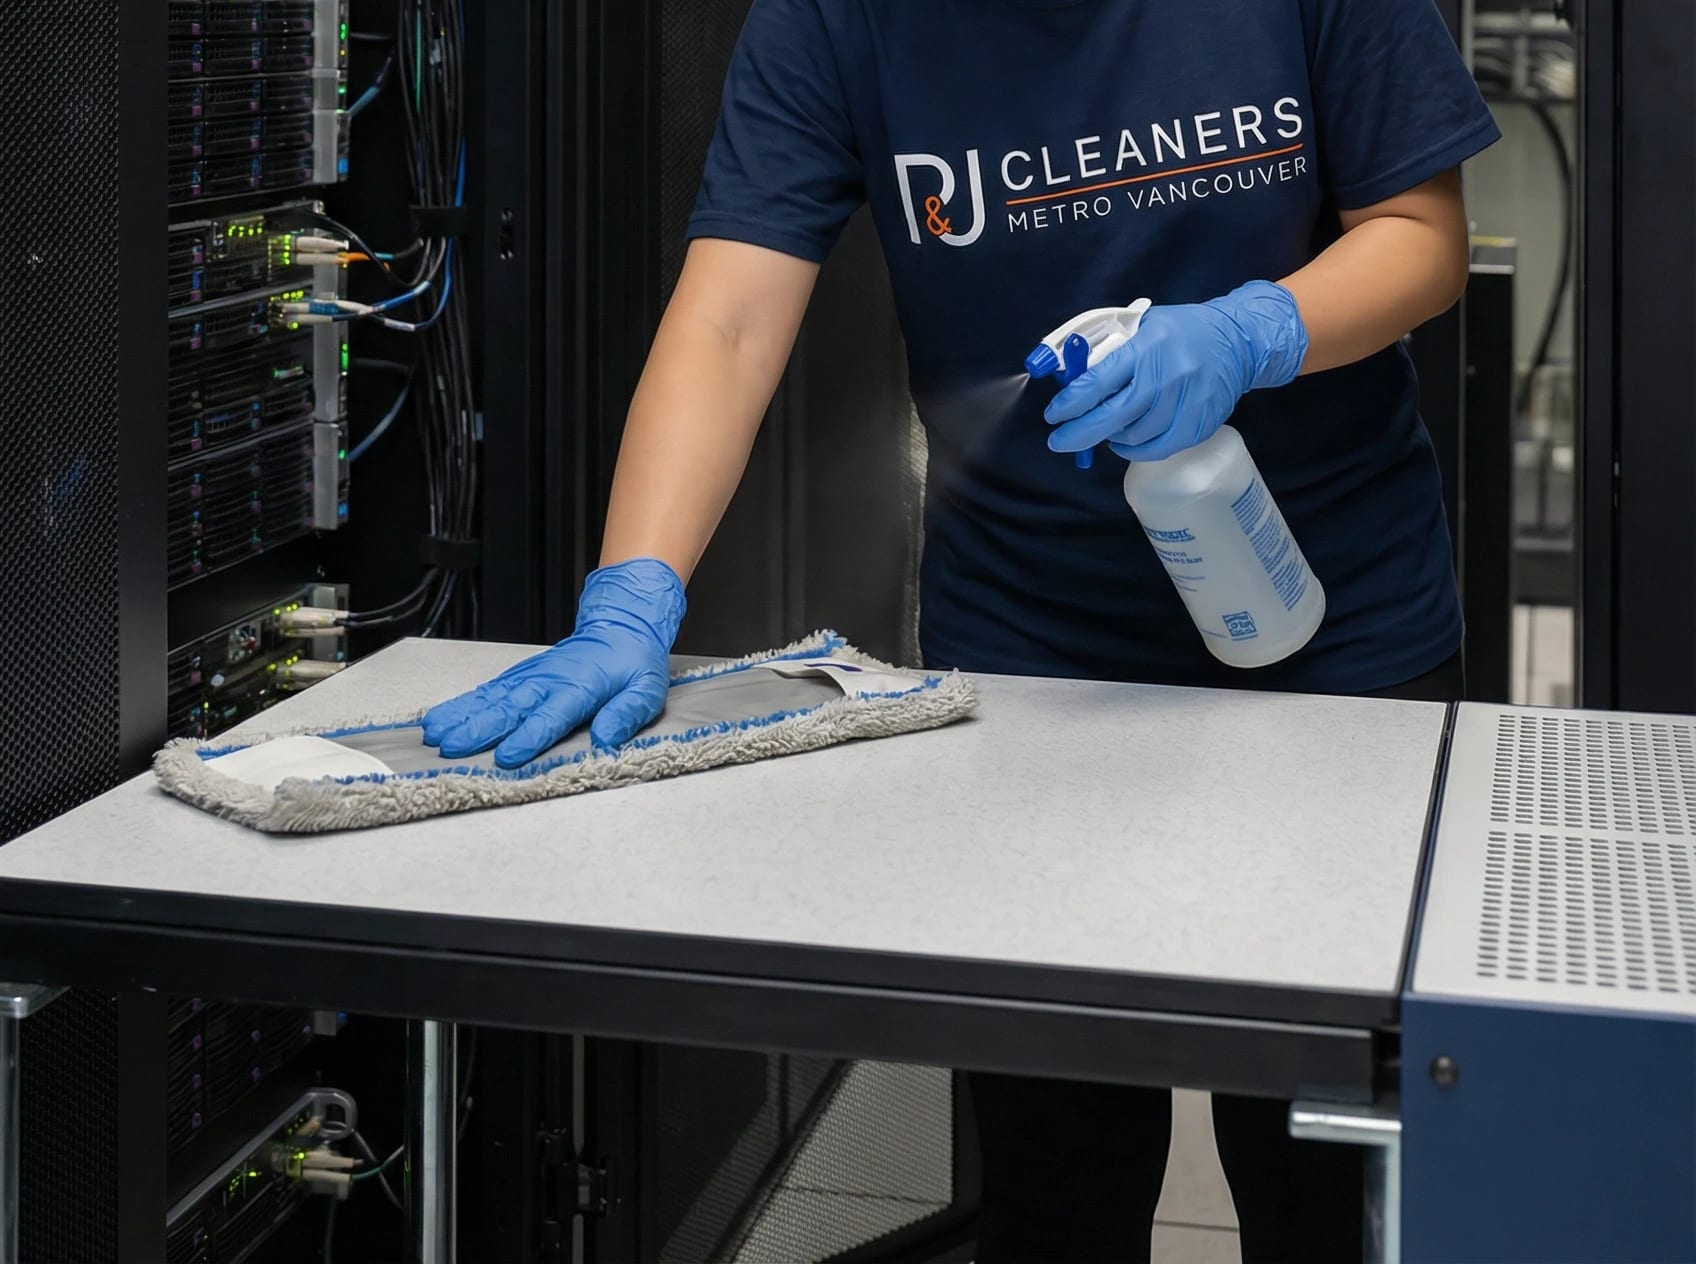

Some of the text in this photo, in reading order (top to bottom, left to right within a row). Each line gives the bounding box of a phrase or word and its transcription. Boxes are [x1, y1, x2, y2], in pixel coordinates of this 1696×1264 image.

[1000, 97, 1304, 192] CLEANERS
[1008, 156, 1308, 233] METRO VANCOUVER
